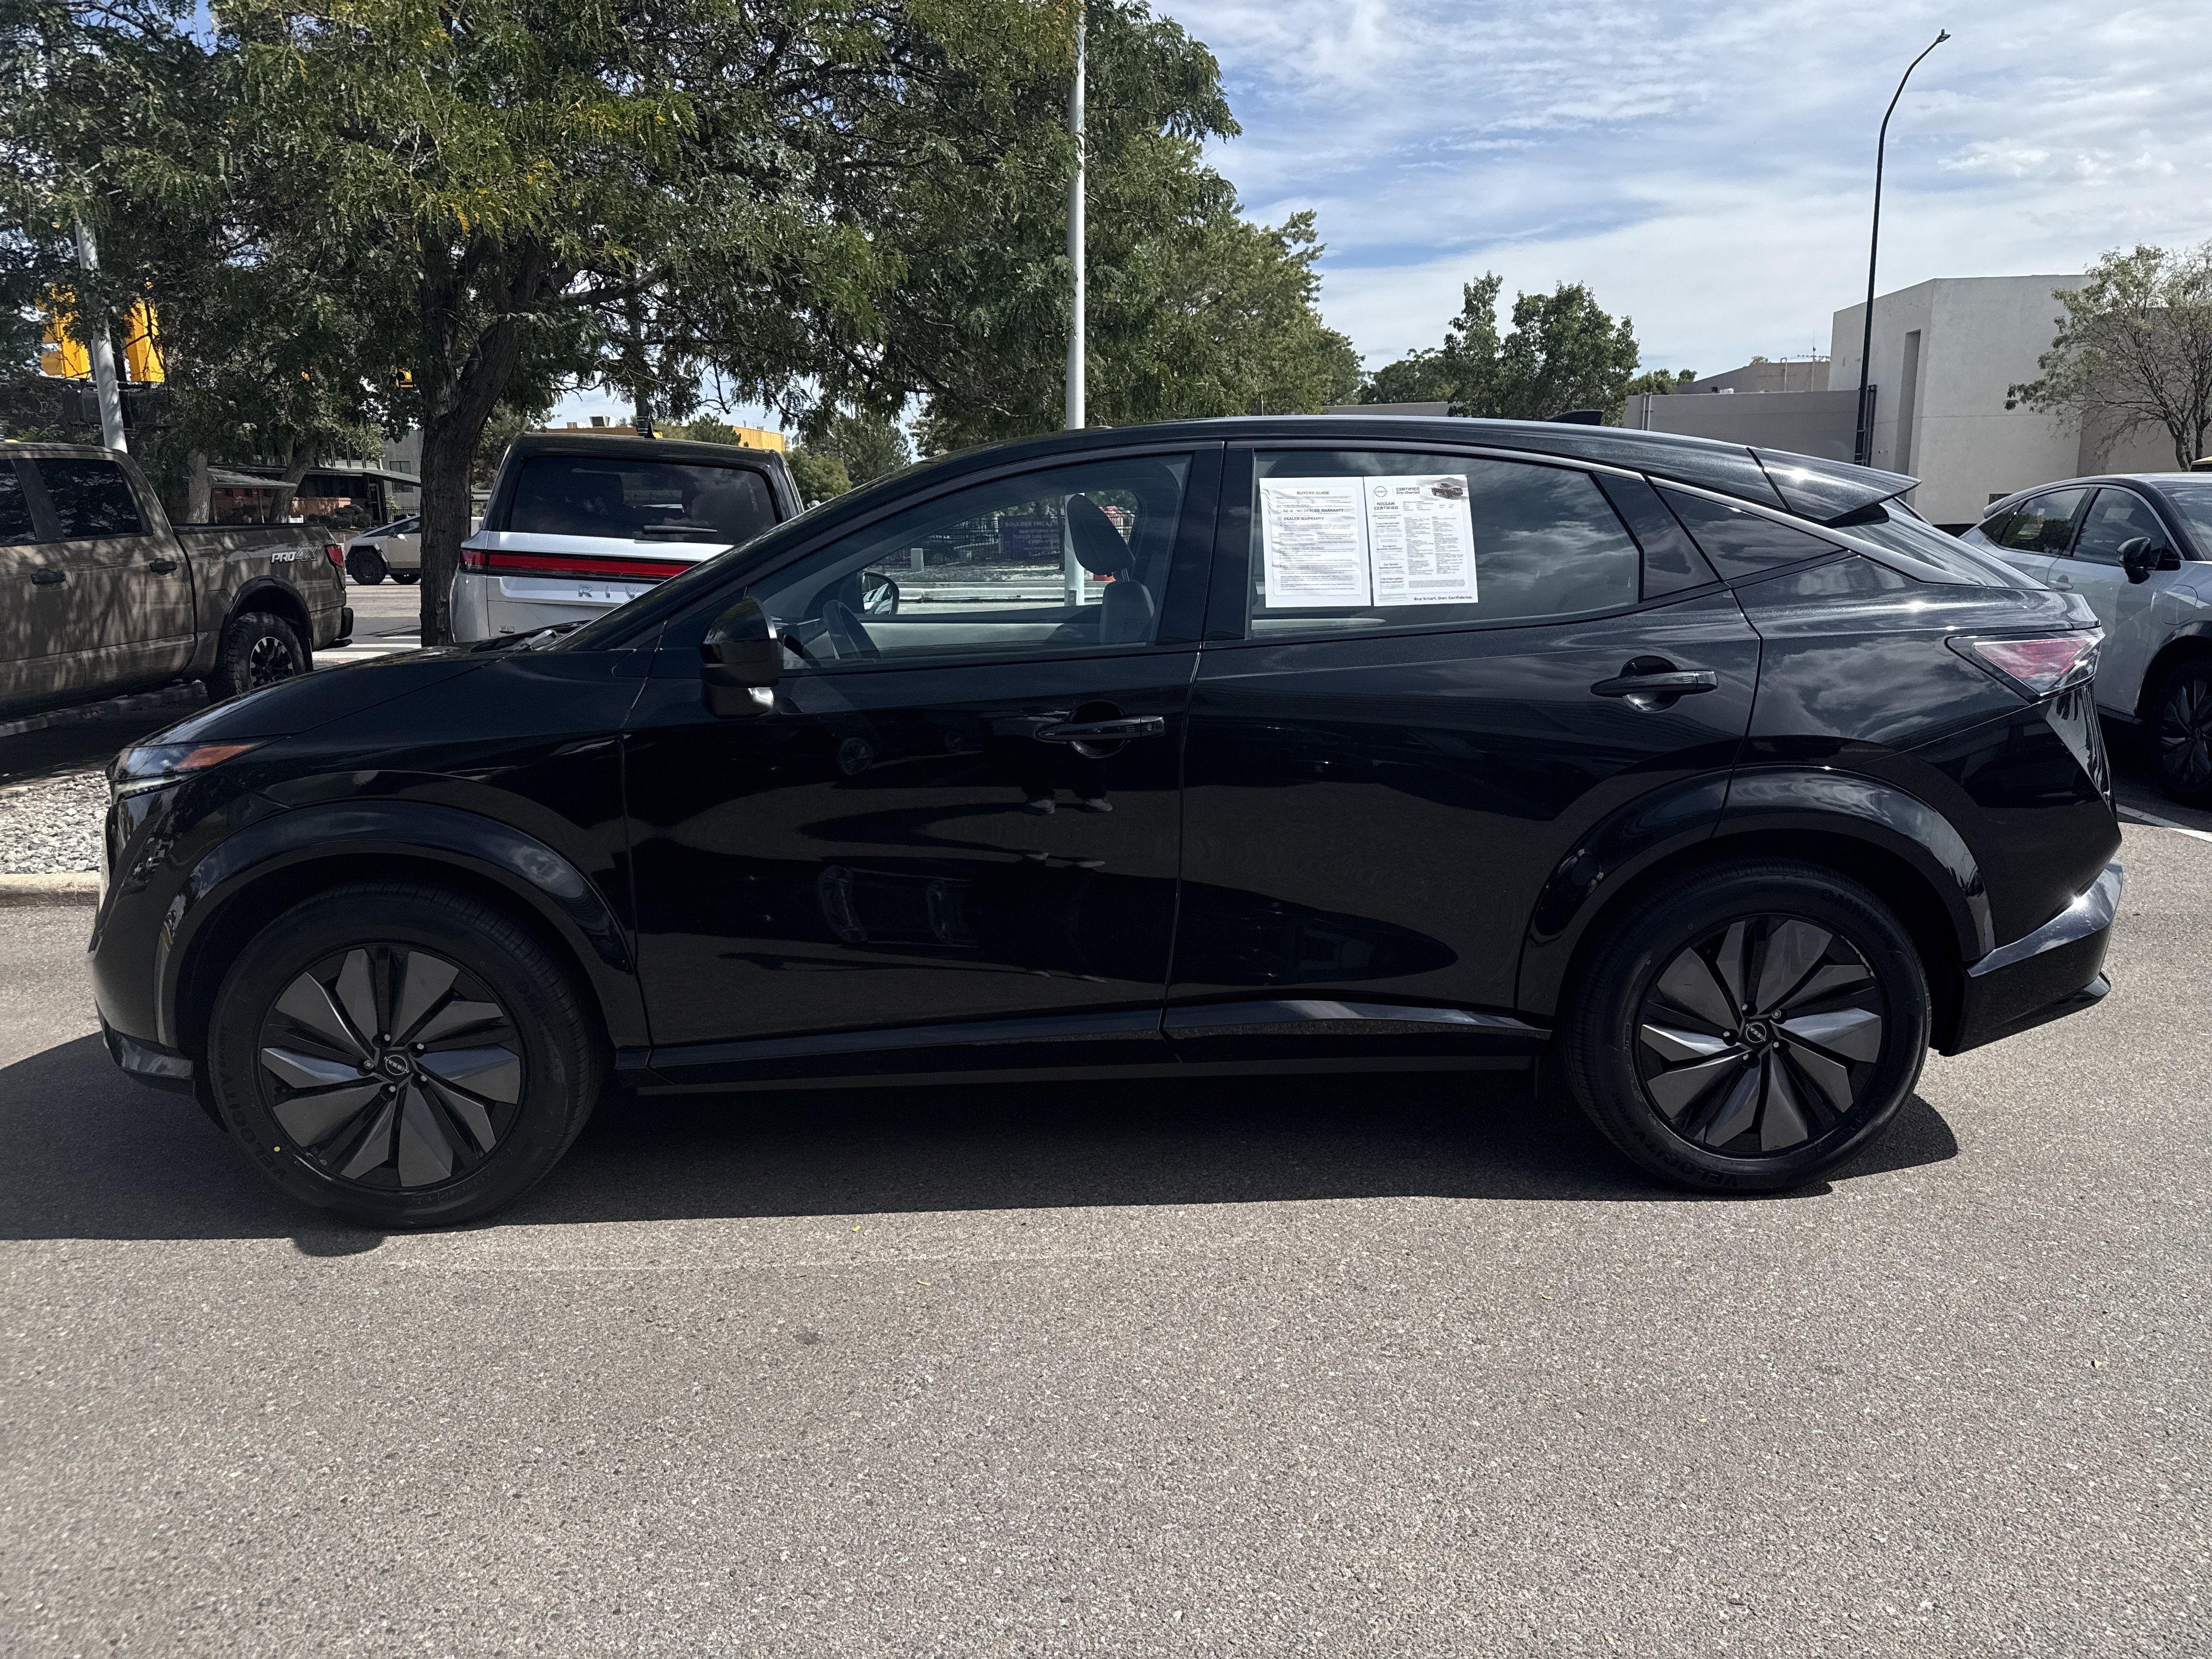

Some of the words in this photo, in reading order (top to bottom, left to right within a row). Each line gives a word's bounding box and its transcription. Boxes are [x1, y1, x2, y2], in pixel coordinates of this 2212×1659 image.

[1746, 1024, 1767, 1041] NISSAN
[384, 1057, 410, 1073] NISSAN
[221, 1071, 288, 1182] VELOCITY
